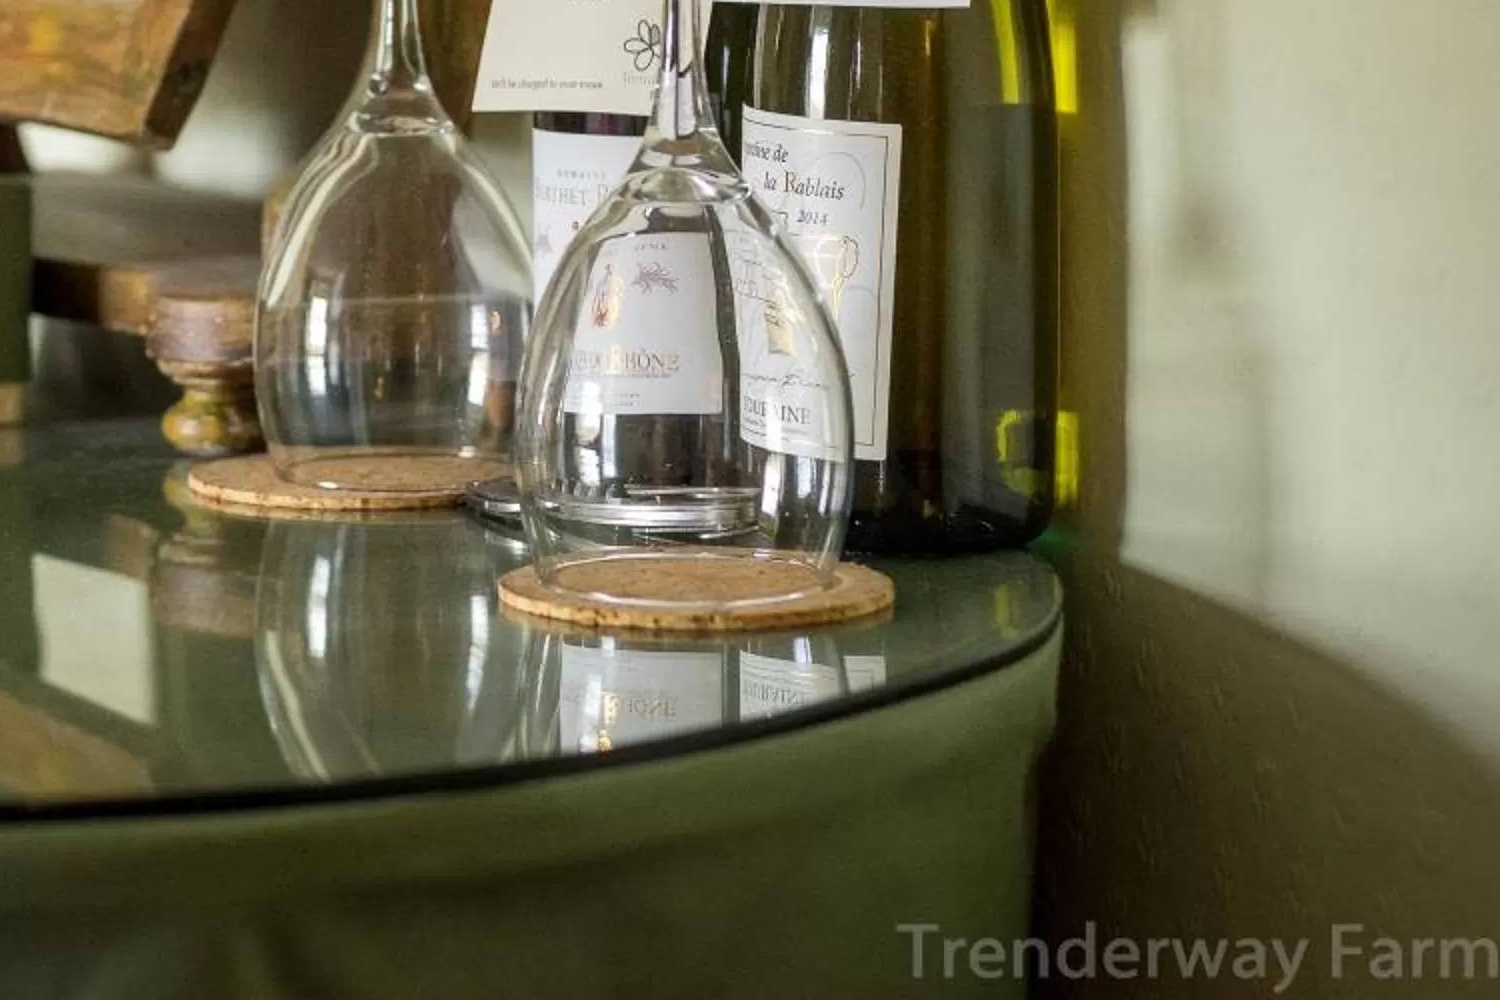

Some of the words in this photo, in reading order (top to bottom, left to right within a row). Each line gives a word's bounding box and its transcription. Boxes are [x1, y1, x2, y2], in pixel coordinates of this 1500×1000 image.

[772, 143, 789, 163] de
[763, 171, 777, 192] la
[783, 170, 846, 201] Rablais
[795, 209, 830, 227] 2014
